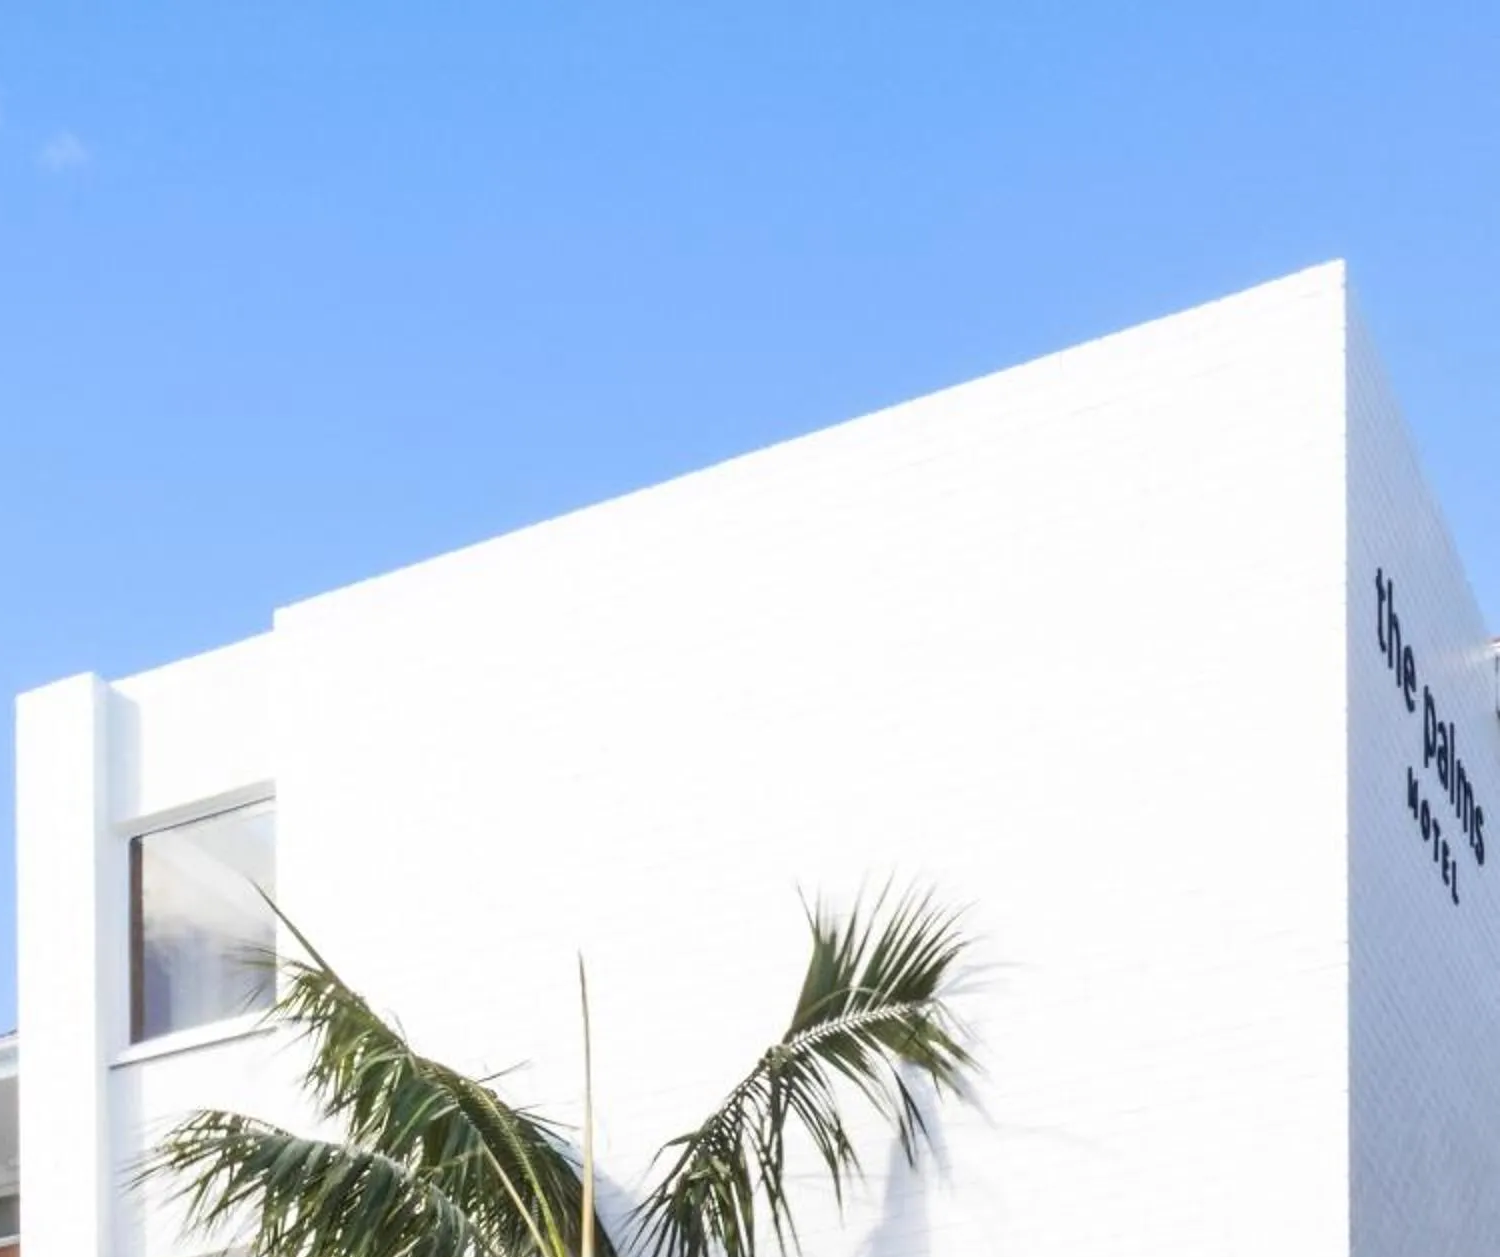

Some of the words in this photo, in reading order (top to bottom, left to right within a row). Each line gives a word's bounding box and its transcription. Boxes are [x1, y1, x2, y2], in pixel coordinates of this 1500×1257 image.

[1375, 567, 1417, 713] the
[1423, 684, 1485, 867] palms
[1407, 765, 1461, 906] MOTEL
